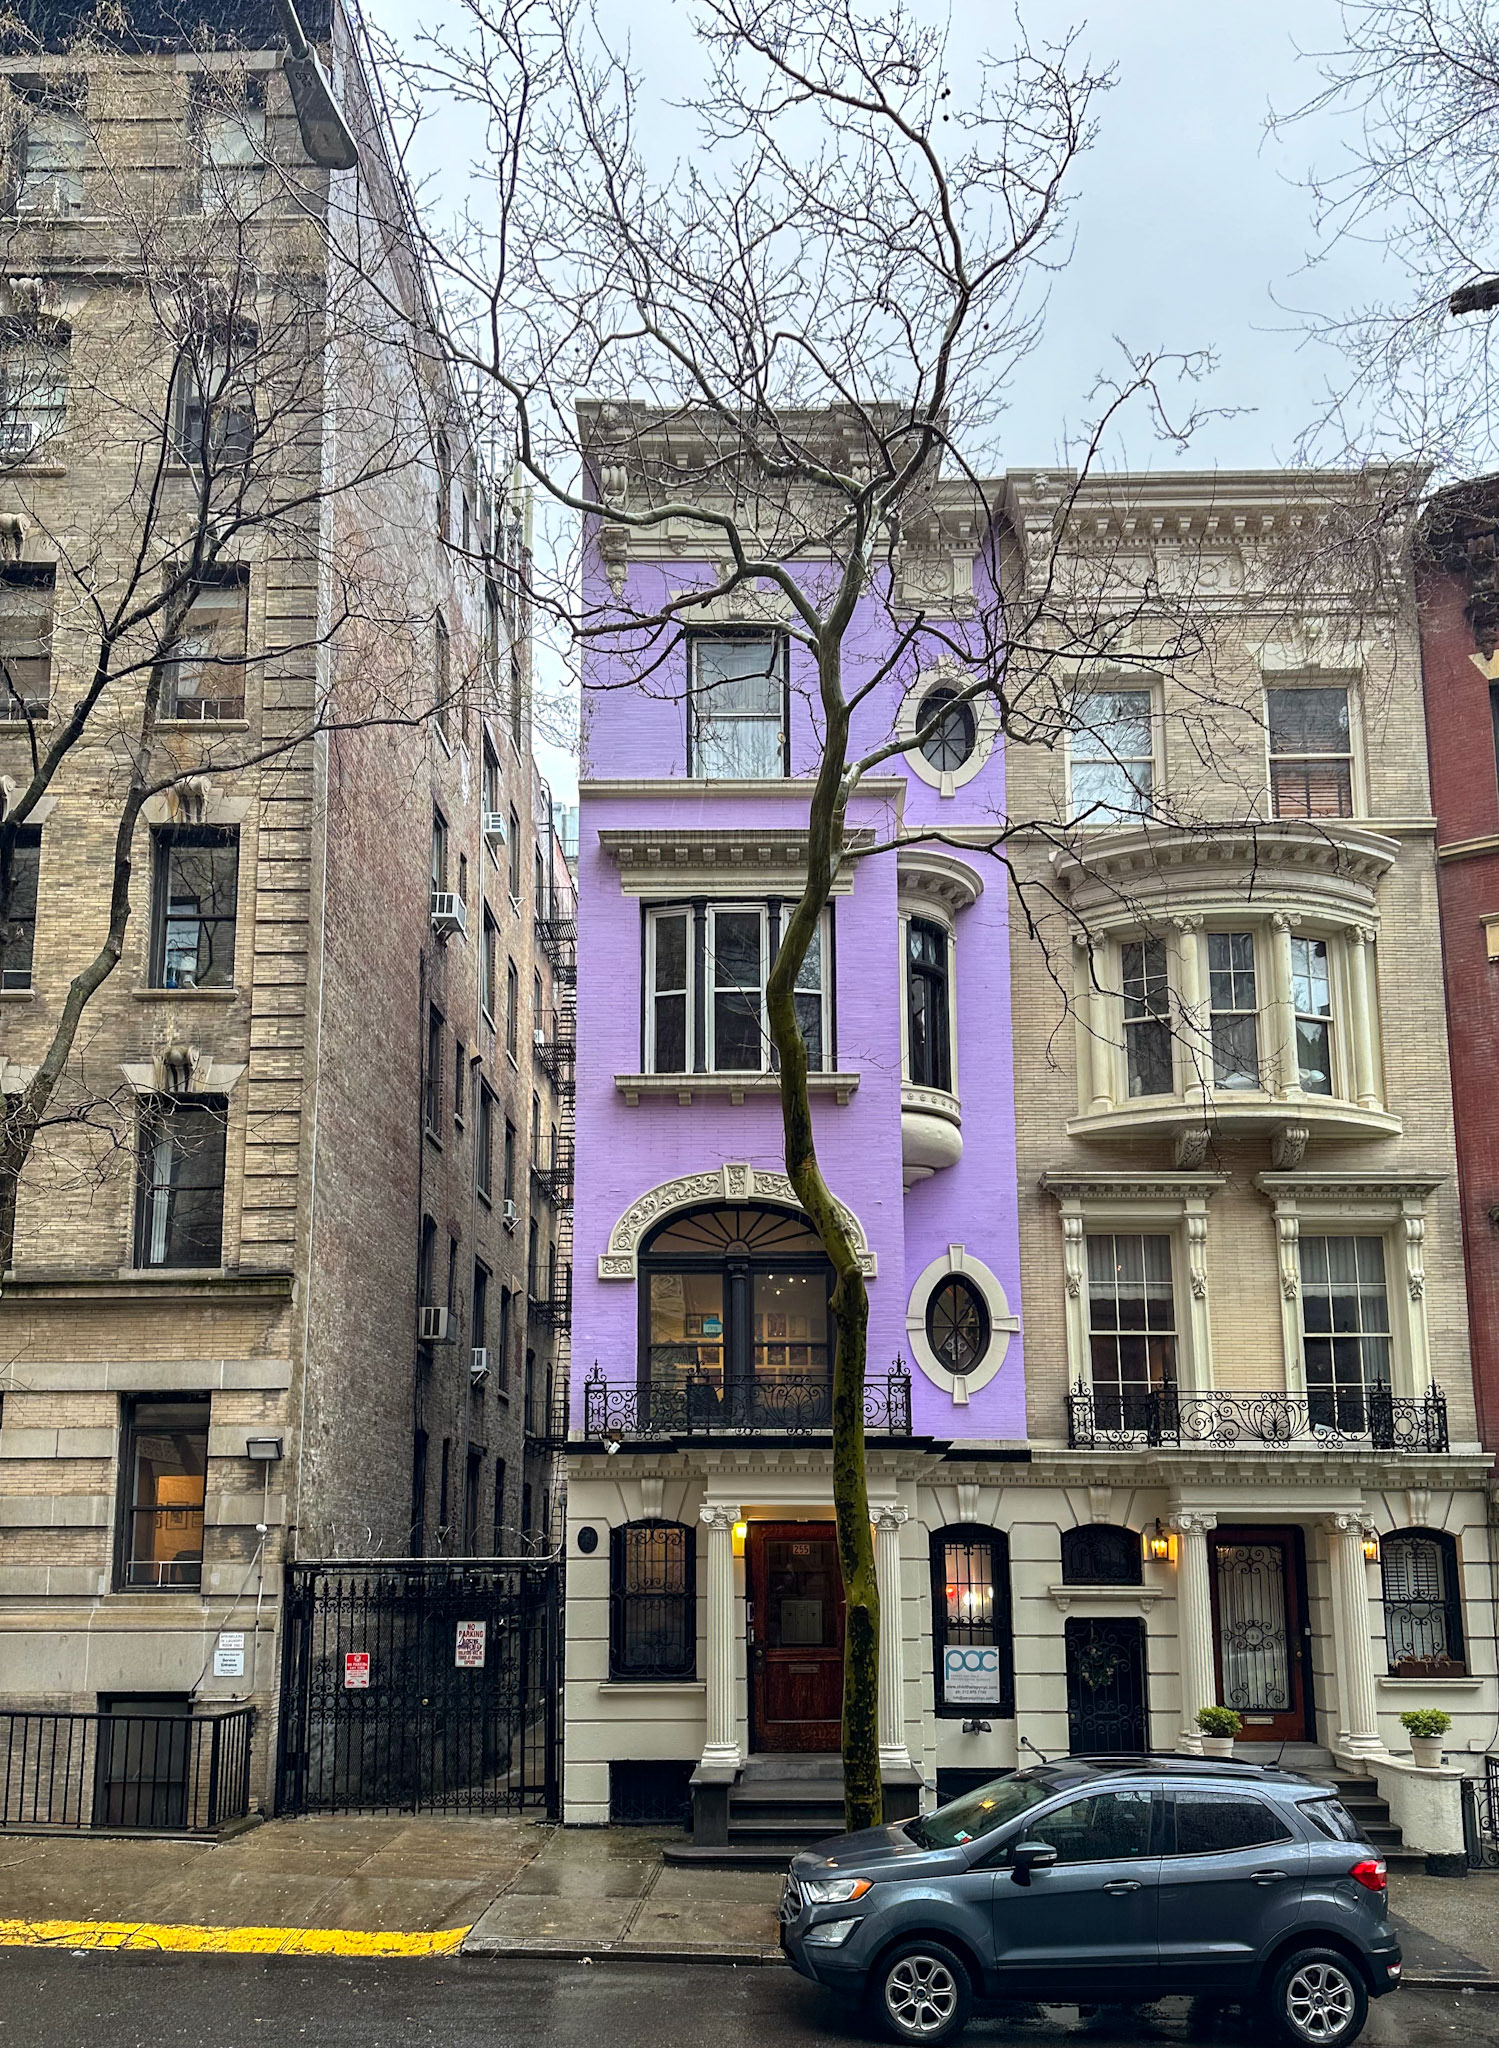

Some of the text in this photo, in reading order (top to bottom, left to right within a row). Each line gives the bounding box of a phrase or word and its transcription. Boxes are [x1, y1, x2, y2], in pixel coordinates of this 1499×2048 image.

[794, 1545, 809, 1554] 255
[467, 1623, 476, 1631] NO
[458, 1630, 483, 1638] PARKING
[945, 1649, 998, 1680] pac
